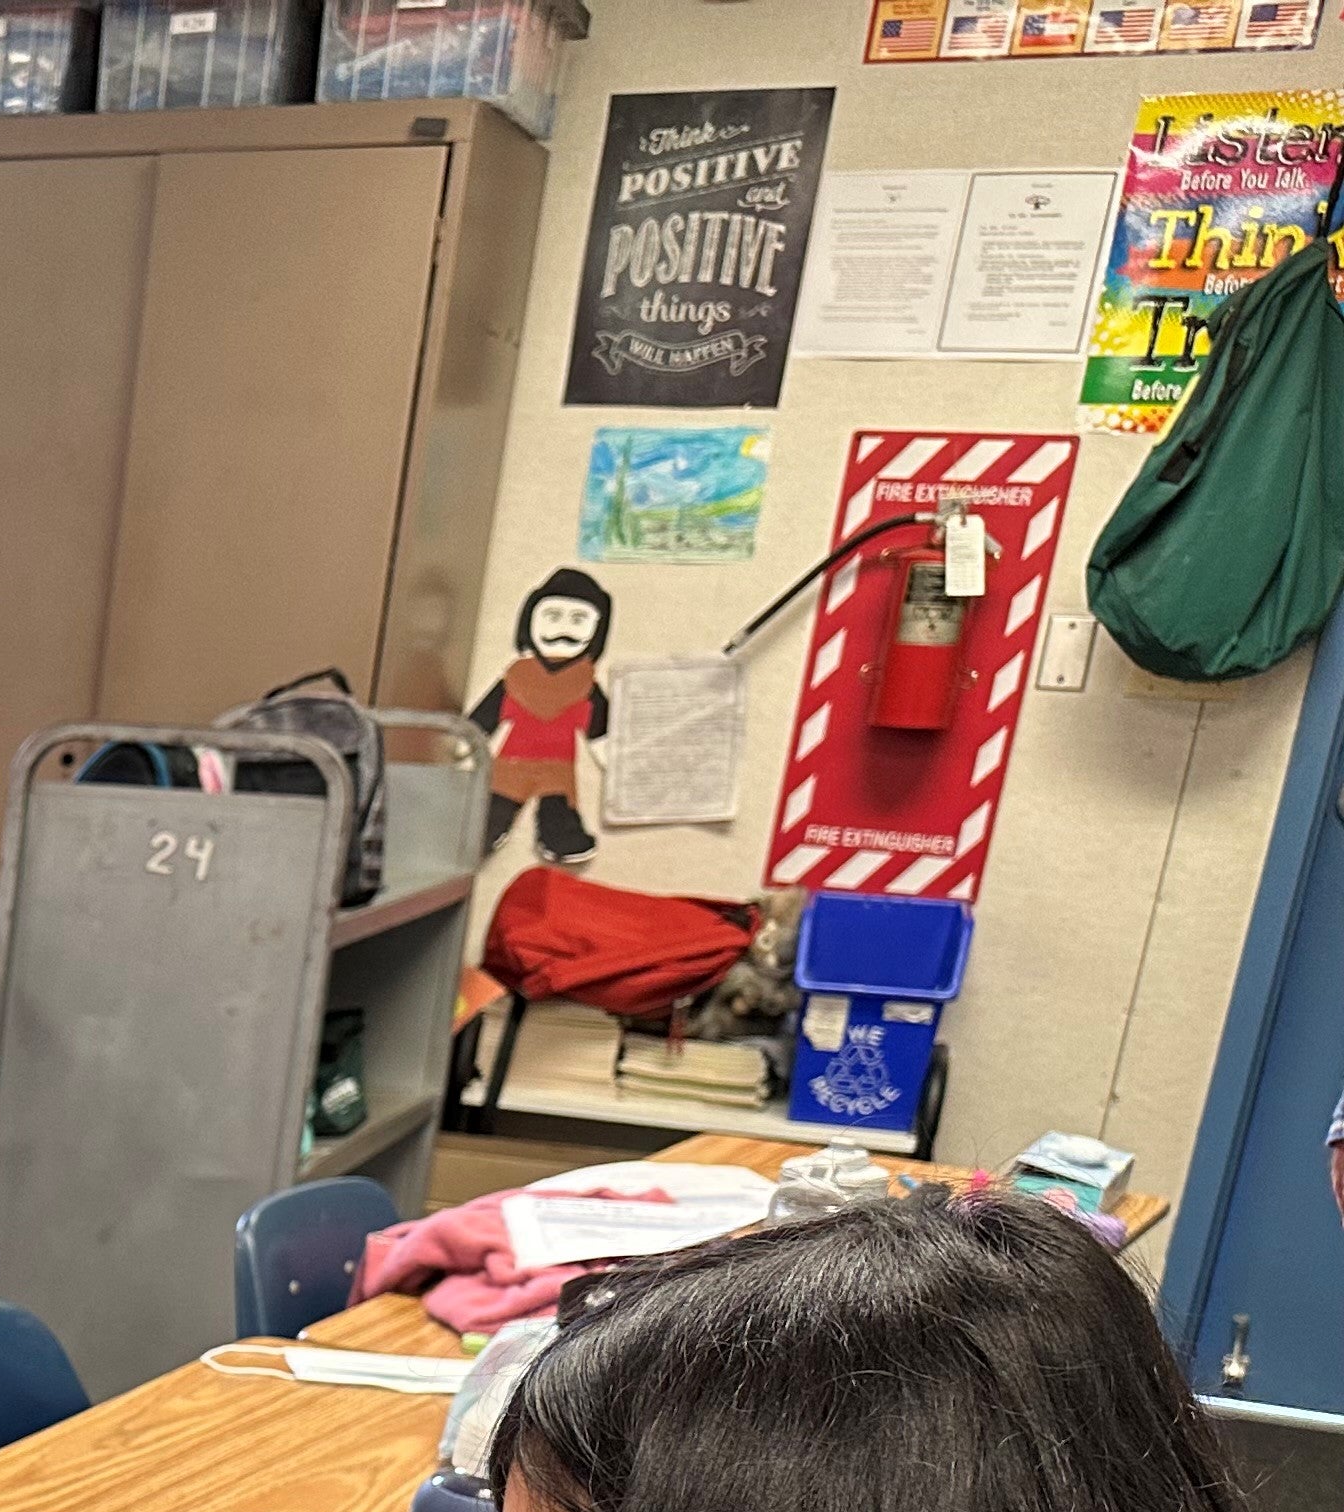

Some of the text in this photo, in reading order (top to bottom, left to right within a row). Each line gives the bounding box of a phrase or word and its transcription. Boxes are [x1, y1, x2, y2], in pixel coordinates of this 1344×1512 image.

[649, 121, 716, 155] Think
[618, 139, 803, 203] POSITIVE
[1180, 169, 1232, 191] Before
[1239, 167, 1268, 190] You
[600, 211, 787, 299] POSITIVE
[640, 289, 732, 336] things
[1129, 295, 1213, 372] Tr
[1131, 380, 1182, 402] Before
[875, 481, 913, 502] FIRE
[145, 830, 215, 881] 24
[803, 824, 956, 856] FIRE EXTINGUISHER
[847, 1024, 886, 1046] WE
[808, 1075, 903, 1116] RECYCLE
